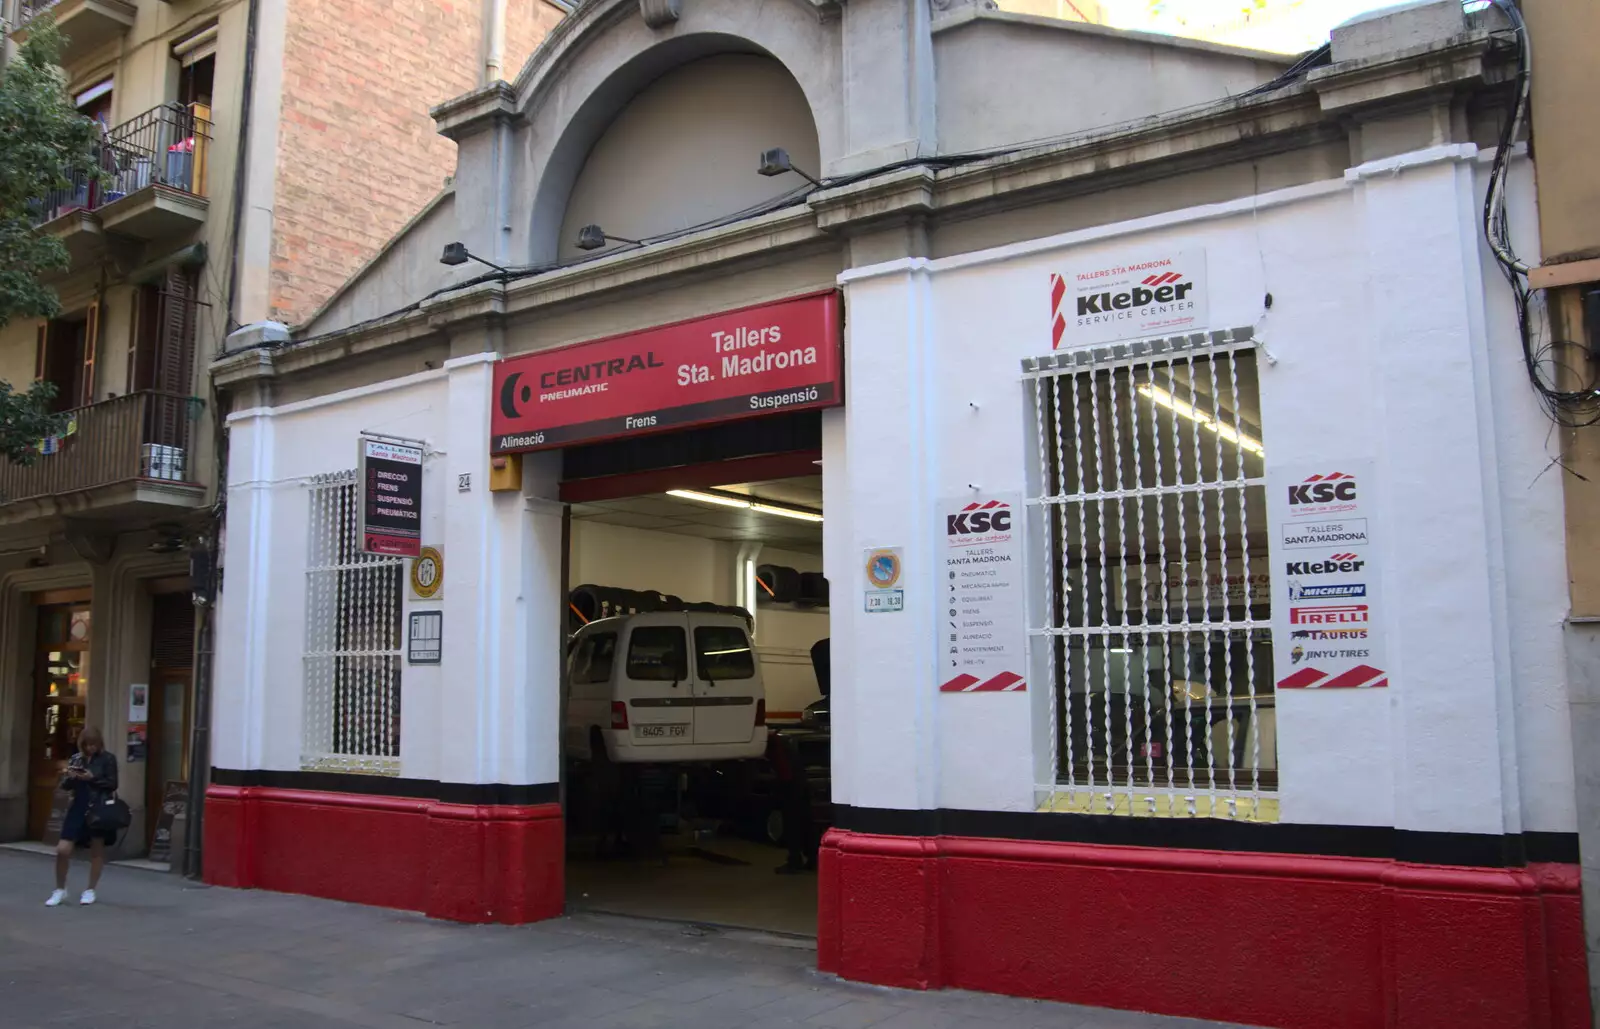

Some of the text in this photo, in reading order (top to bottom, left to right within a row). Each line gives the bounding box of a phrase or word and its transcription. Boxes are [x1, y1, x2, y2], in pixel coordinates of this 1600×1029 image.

[1077, 259, 1172, 281] TALLERS STA MADRONA
[1077, 282, 1193, 316] Kleber
[1077, 311, 1133, 326] SERVICE
[1141, 301, 1194, 316] CENTER
[711, 325, 781, 353] Tallers
[540, 351, 664, 389] CENTRAL
[677, 346, 817, 386] Sta. Madrona
[540, 382, 608, 403] PNEUMATIC
[750, 387, 818, 409] Suspensió
[625, 414, 657, 429] Frens
[500, 432, 545, 448] Alineació
[371, 444, 420, 455] TALLERS
[371, 450, 389, 458] Santa
[377, 482, 399, 492] FRENS
[459, 476, 470, 488] 24
[1288, 481, 1356, 505] KSC
[947, 510, 1011, 536] KSC
[1305, 525, 1344, 533] TALLERS
[1284, 532, 1367, 545] SANTA MADRONA
[965, 548, 995, 556] TALLERS
[947, 555, 1012, 566] SANTA MADRONA
[1286, 560, 1365, 575] Kleber
[1303, 586, 1364, 596] MICHELIN
[1290, 605, 1369, 625] PIRELLI
[1310, 629, 1368, 640] TAURUS
[1304, 649, 1370, 661] JINYU TIRES
[642, 726, 664, 737] 8405
